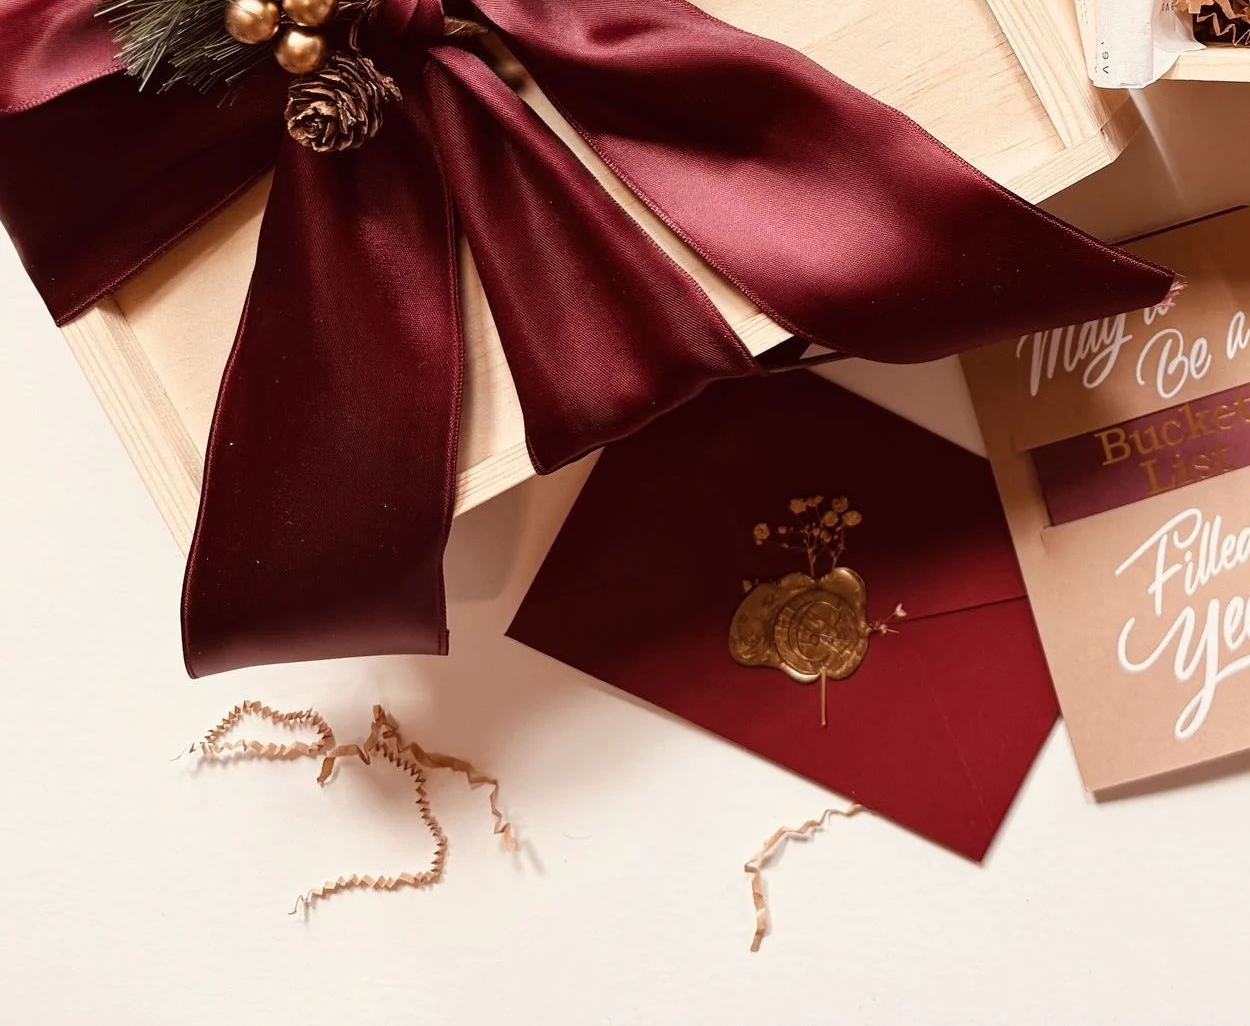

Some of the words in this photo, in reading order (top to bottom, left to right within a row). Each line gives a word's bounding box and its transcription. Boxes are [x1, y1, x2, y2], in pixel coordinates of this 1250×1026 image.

[1136, 327, 1213, 399] Be
[1226, 311, 1250, 360] a
[1139, 446, 1235, 494] List
